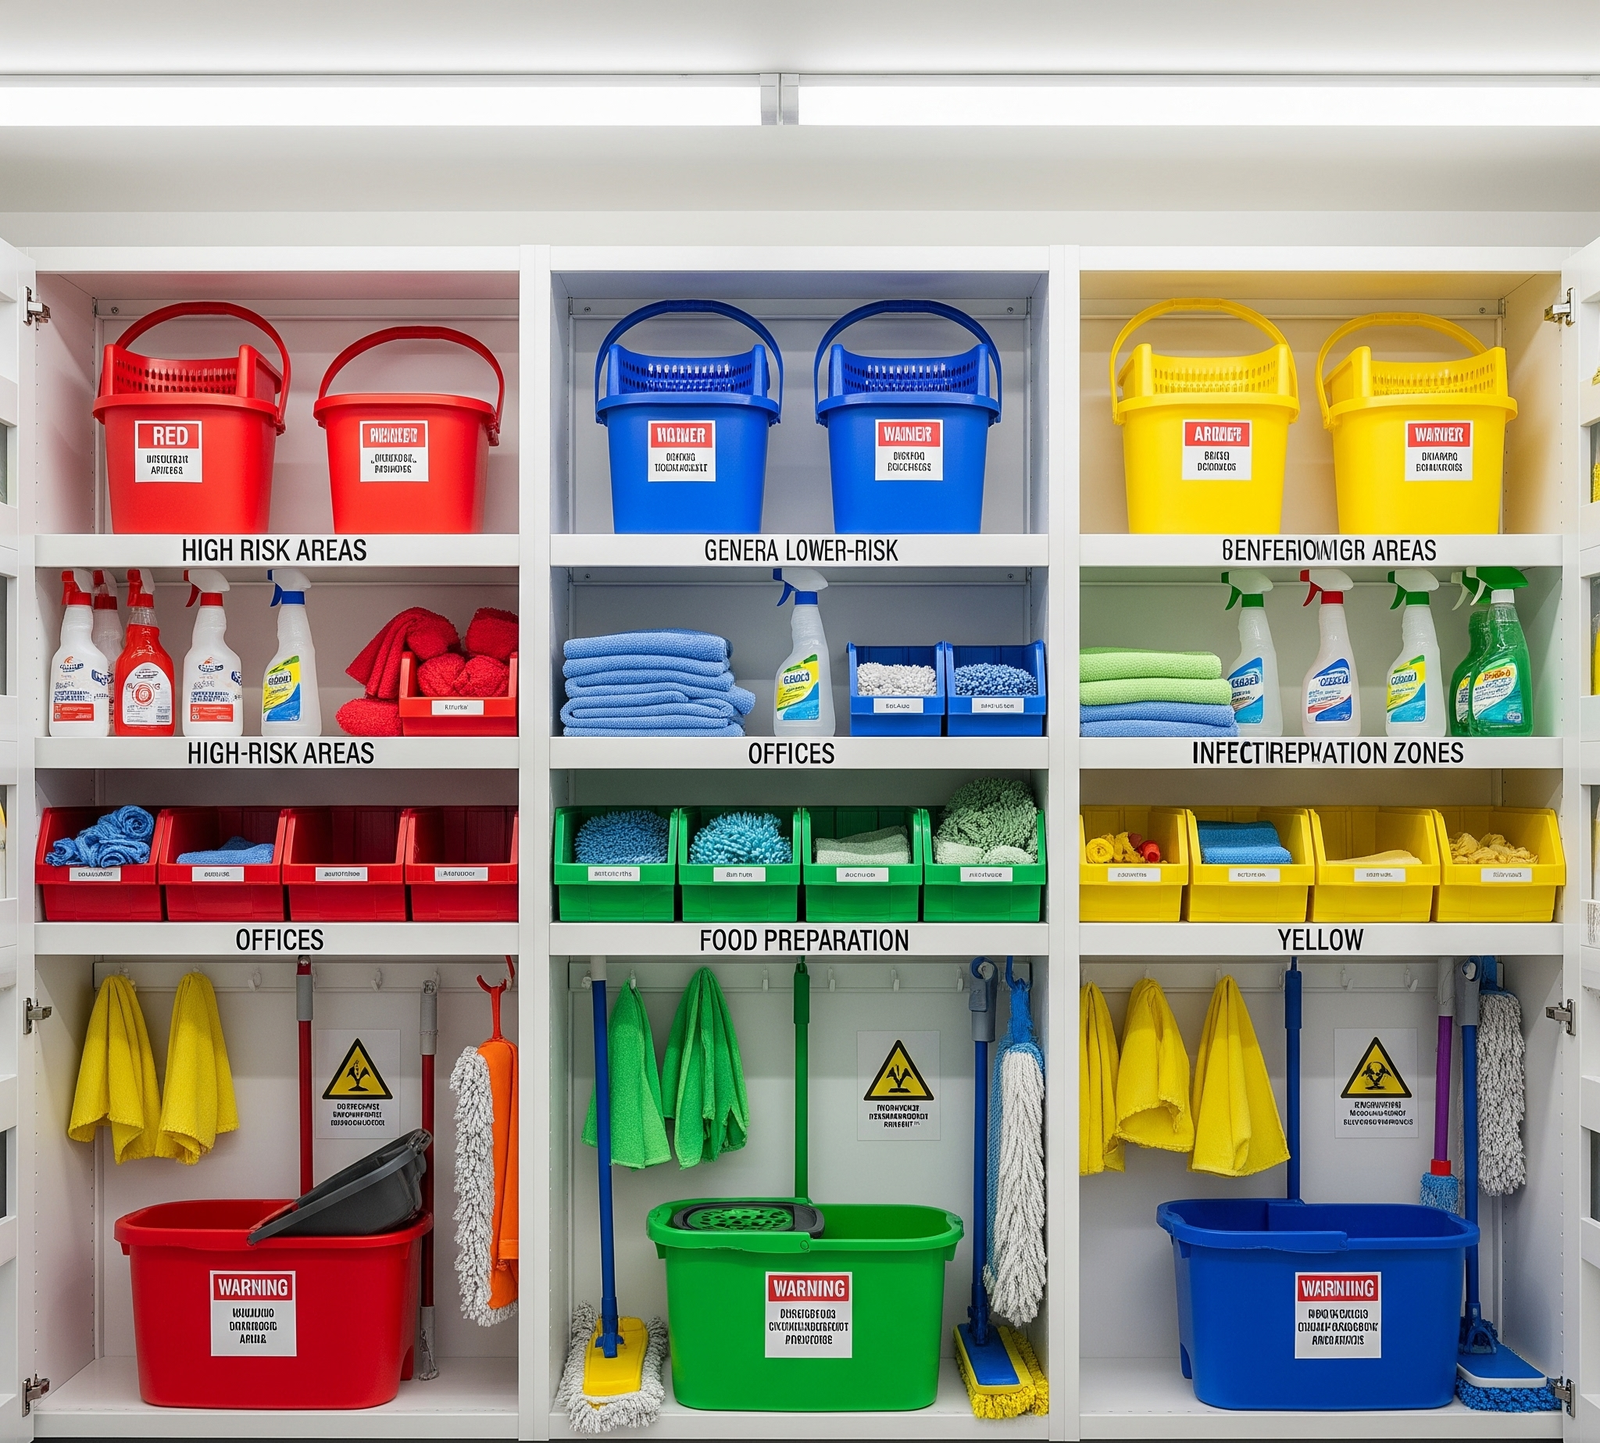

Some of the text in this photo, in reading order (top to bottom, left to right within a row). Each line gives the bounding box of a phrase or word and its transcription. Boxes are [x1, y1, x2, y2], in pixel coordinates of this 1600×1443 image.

[153, 426, 189, 446] RED
[182, 538, 367, 562] HIGH RISK AREAS
[704, 538, 899, 562] GENERA LOWER-RISK
[1371, 539, 1437, 562] AREAS
[188, 741, 375, 765] HIGH-RISK AREAS
[748, 742, 835, 765] OFFICES
[1393, 741, 1464, 765] ZONES
[236, 928, 324, 951] OFFICES
[700, 928, 909, 952] FOOD PREPARATION
[1278, 928, 1364, 951] YELLOW
[217, 1278, 289, 1297] WARNING
[773, 1279, 846, 1298] WARNING
